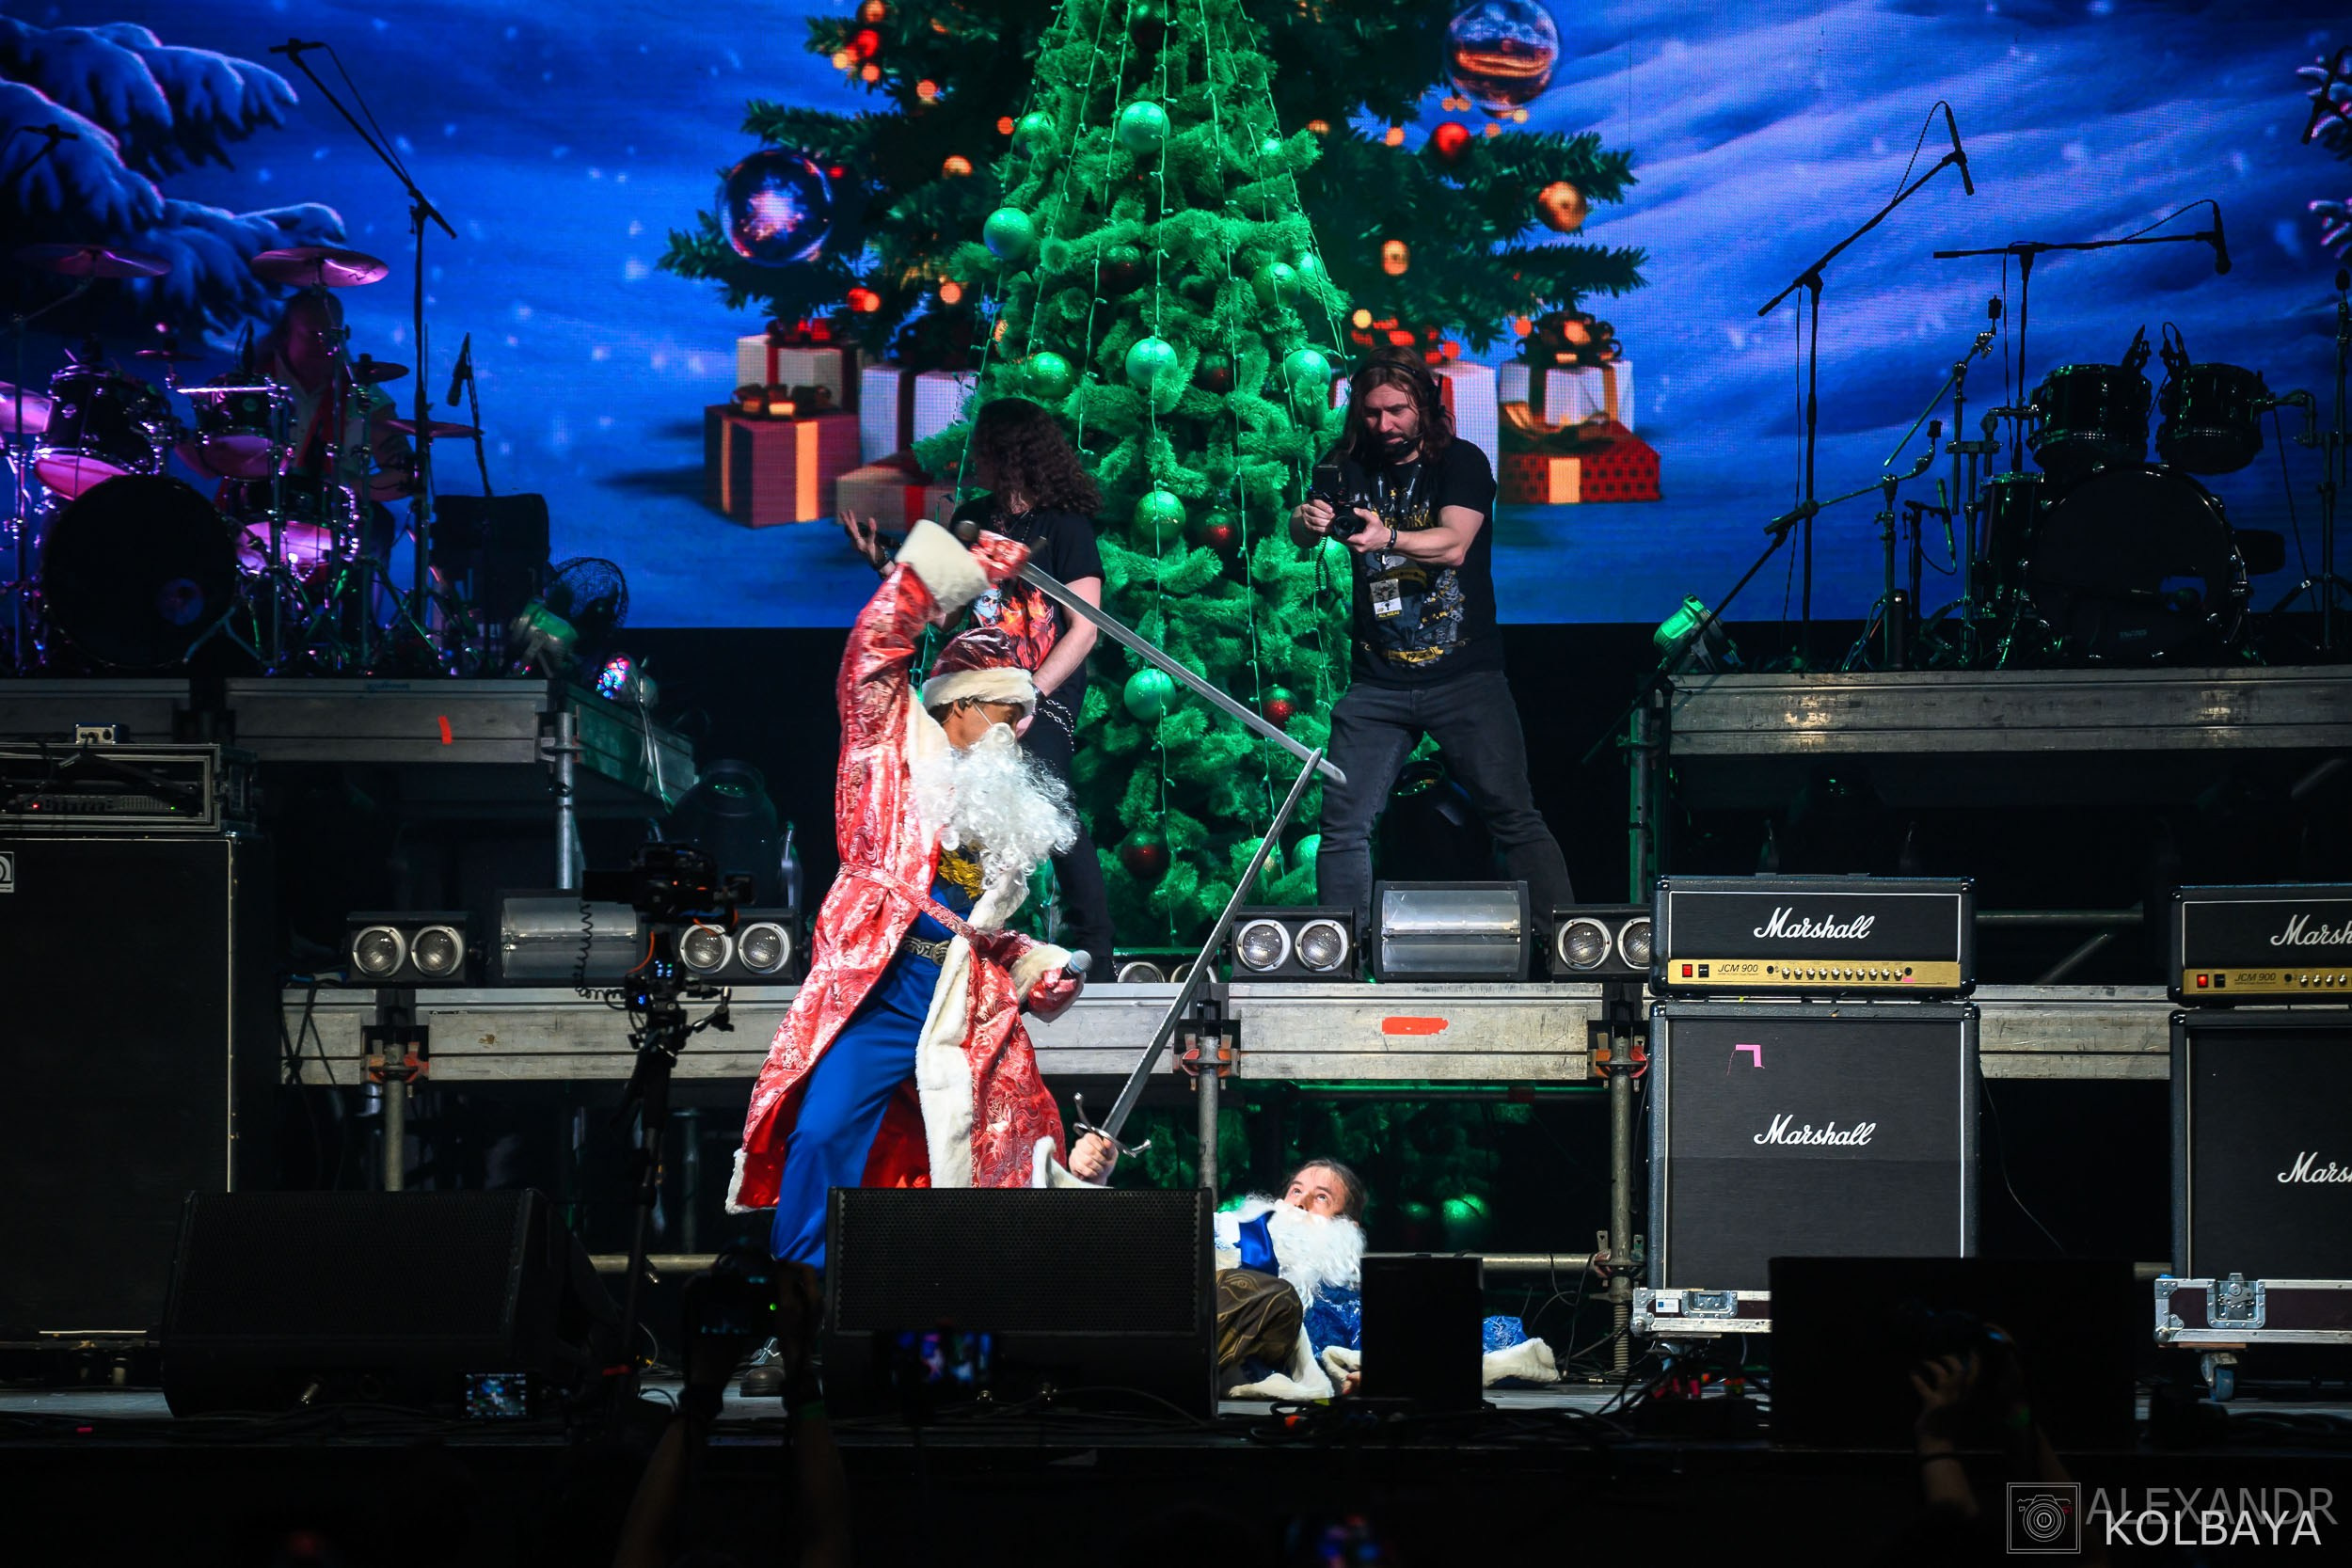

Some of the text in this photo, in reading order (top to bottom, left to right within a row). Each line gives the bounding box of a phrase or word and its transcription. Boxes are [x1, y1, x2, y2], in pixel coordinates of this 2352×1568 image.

[1753, 907, 1875, 939] Marshall
[1718, 964, 1758, 973] JCM 900
[2234, 973, 2277, 982] JCM 900
[1753, 1114, 1877, 1146] Marshall
[2277, 1151, 2352, 1182] Mars
